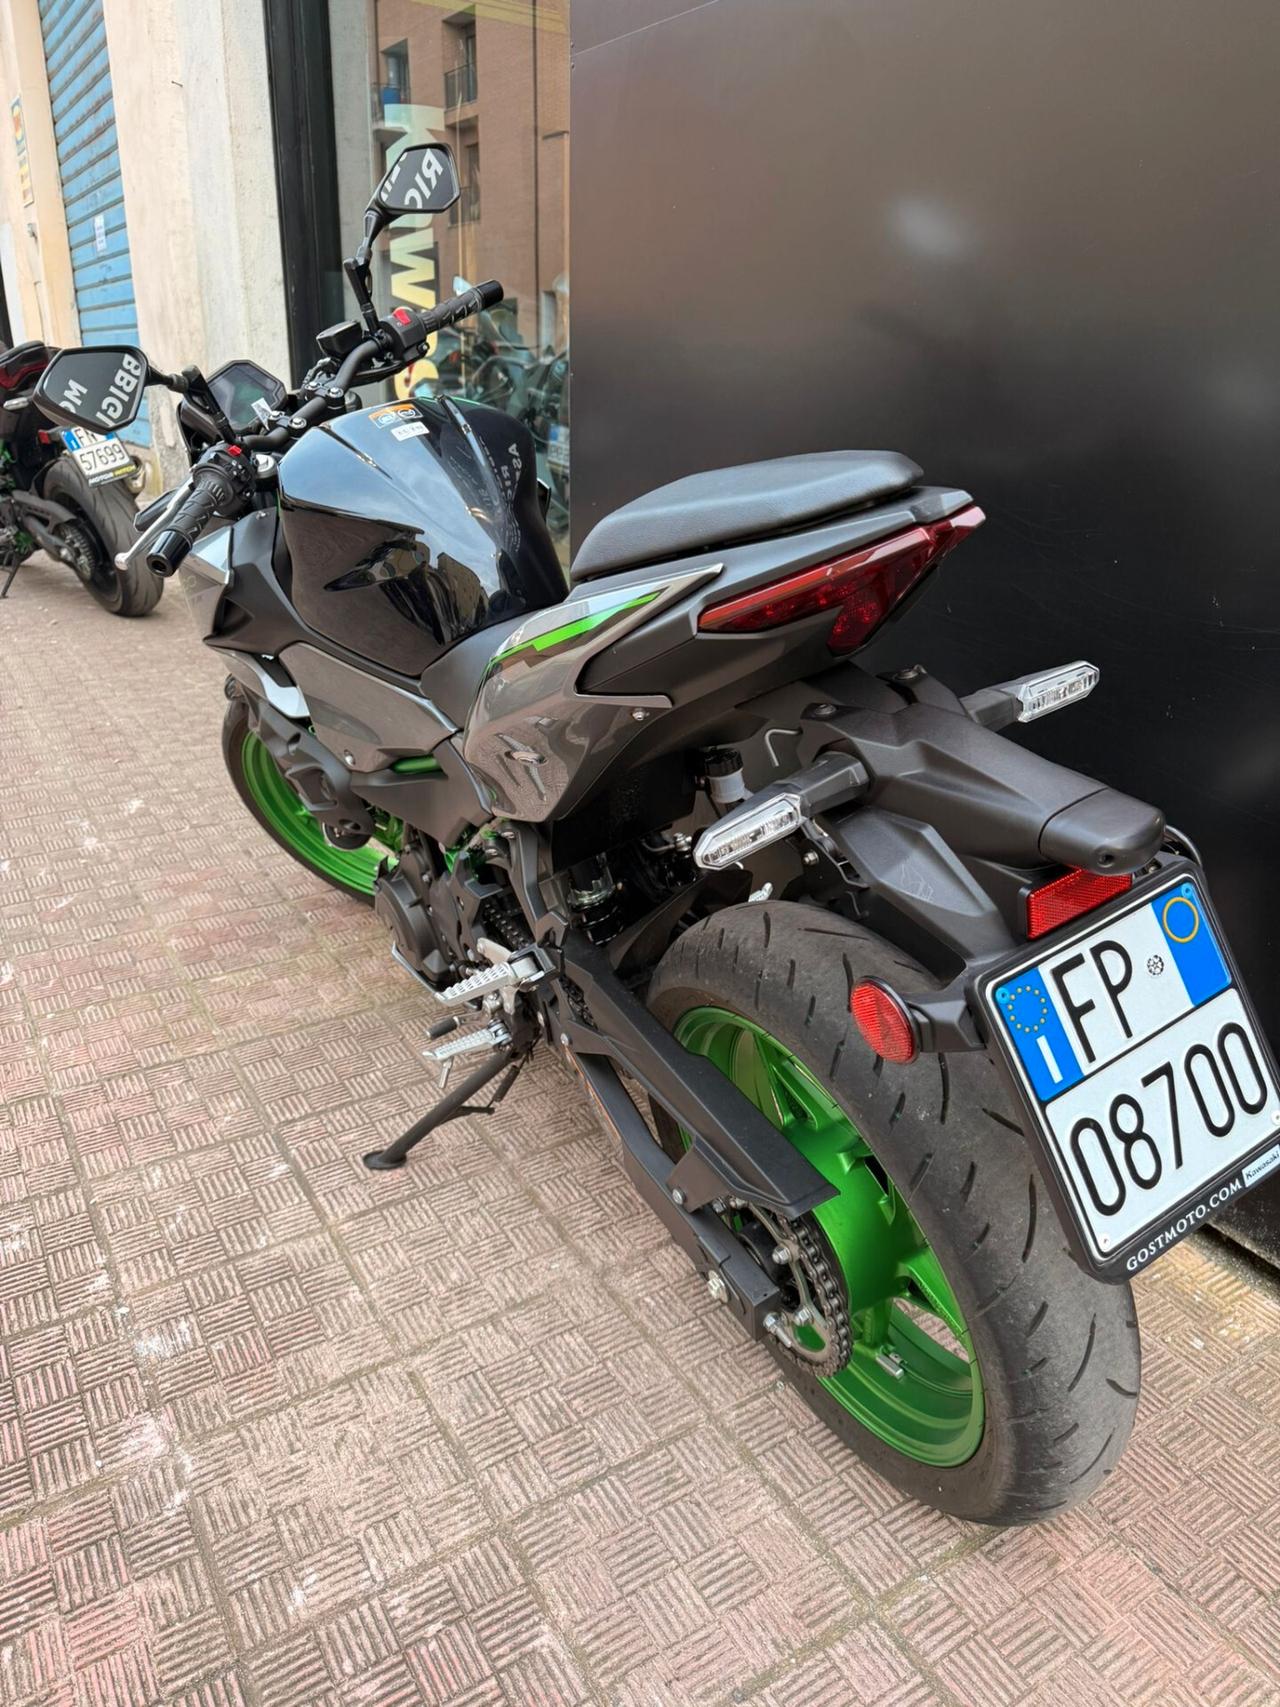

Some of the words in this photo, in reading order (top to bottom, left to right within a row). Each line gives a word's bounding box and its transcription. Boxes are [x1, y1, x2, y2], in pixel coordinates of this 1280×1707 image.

[80, 443, 125, 471] 57699
[1050, 940, 1133, 1063] FP
[1070, 1022, 1268, 1216] 08700
[1126, 1178, 1243, 1271] GOSTMOTO.COM
[1246, 1150, 1280, 1180] Kawasaki
